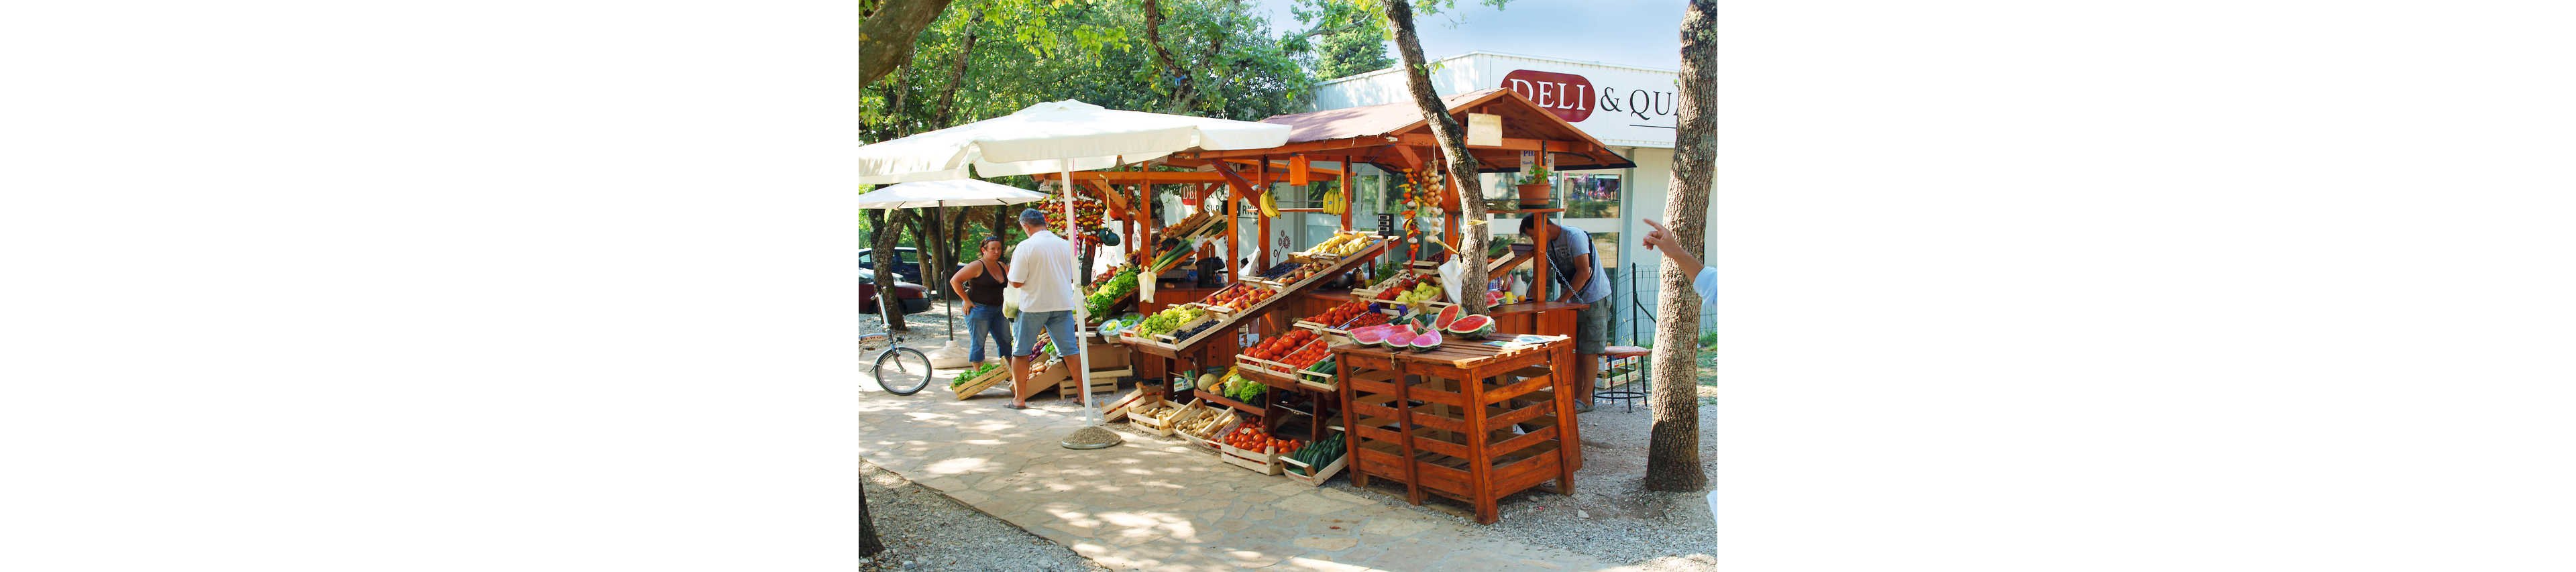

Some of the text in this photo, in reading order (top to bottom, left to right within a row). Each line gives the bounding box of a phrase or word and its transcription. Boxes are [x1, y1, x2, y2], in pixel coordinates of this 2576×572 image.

[1509, 78, 1678, 121] DELI & QU
